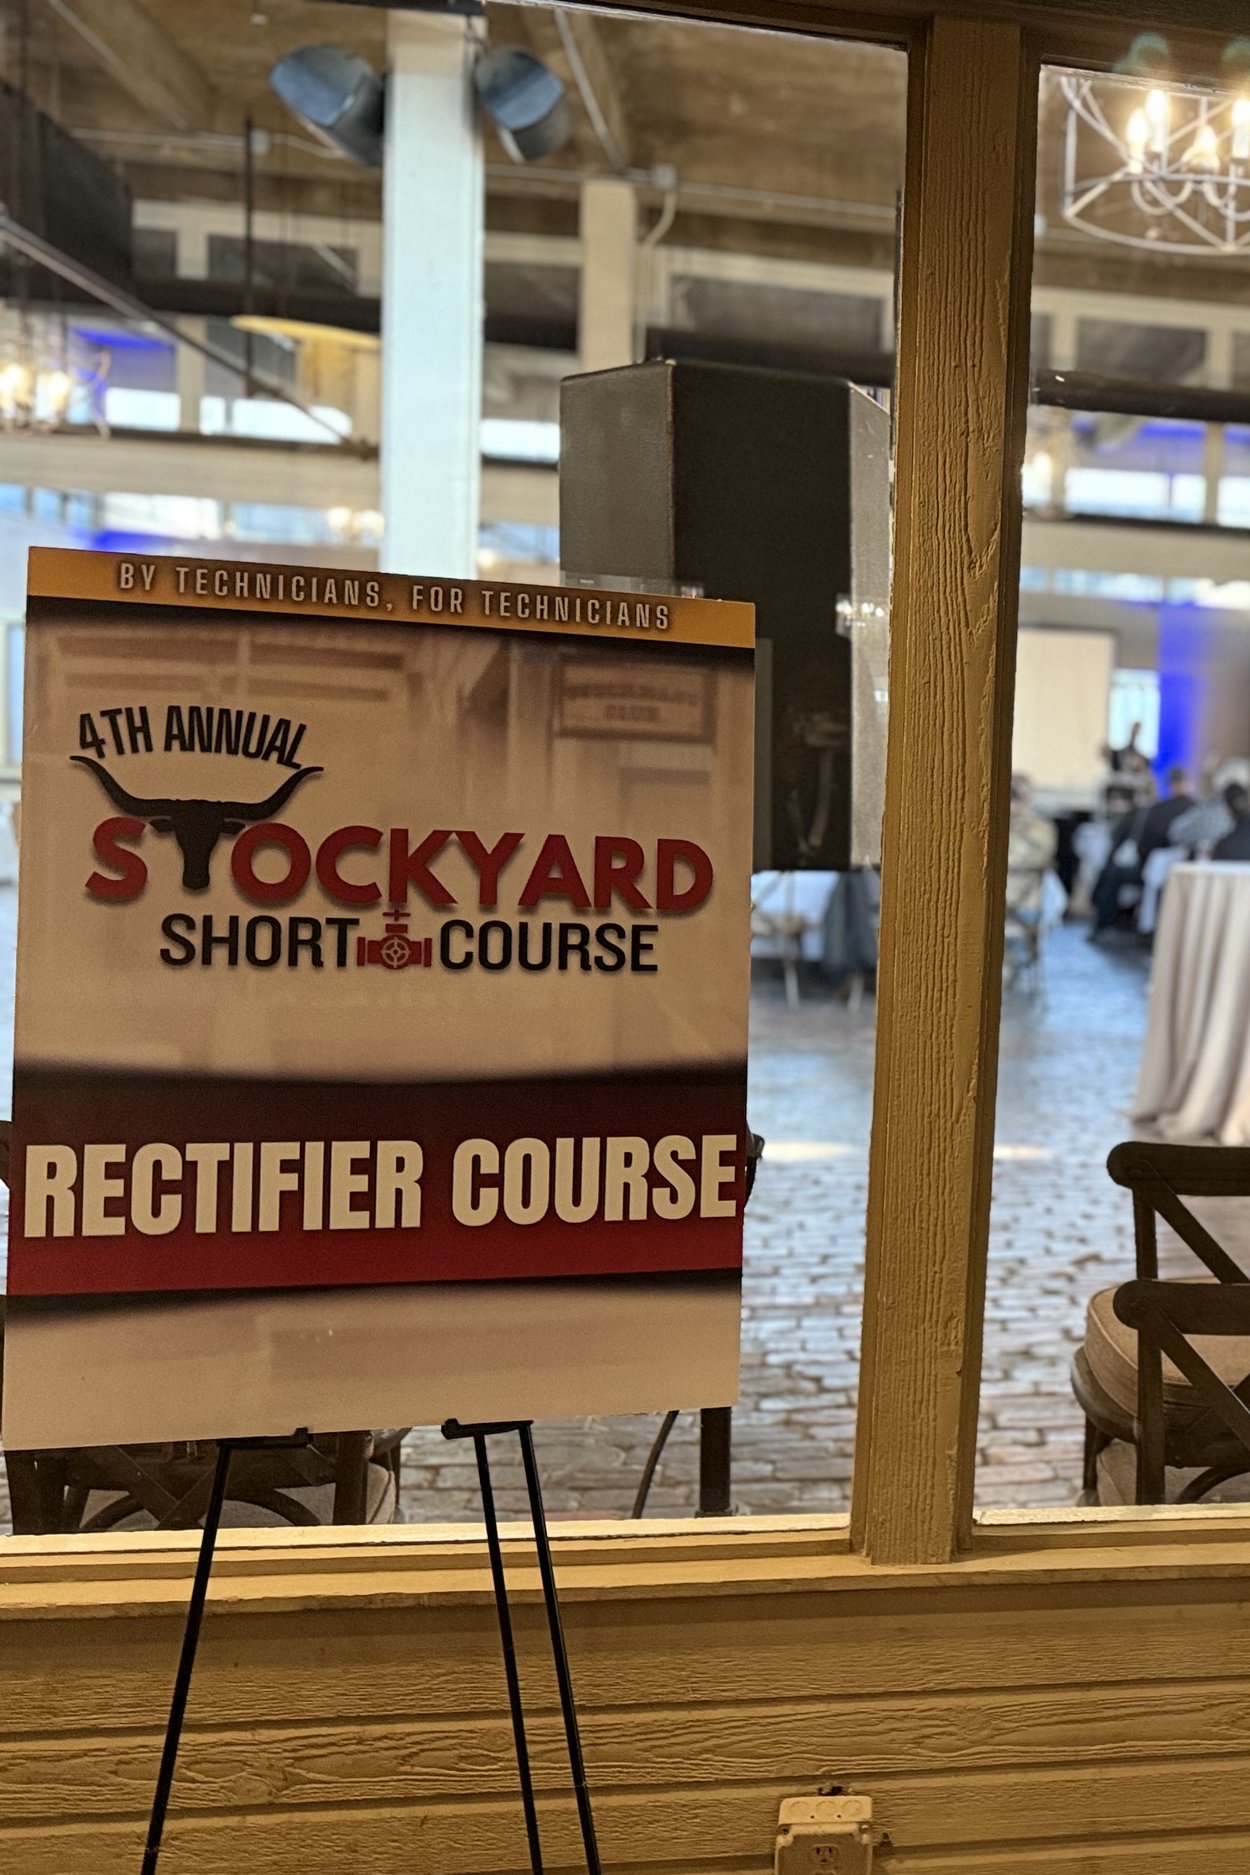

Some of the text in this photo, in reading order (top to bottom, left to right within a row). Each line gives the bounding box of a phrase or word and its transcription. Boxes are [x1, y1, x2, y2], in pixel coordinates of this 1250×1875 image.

[119, 562, 670, 630] BY TECHNICIANS, FOR TECHNICIANS
[79, 704, 307, 770] 4TH ANNUAL
[159, 913, 659, 973] SHORT COURSE
[23, 1133, 738, 1239] RECTIFIER COURSE
